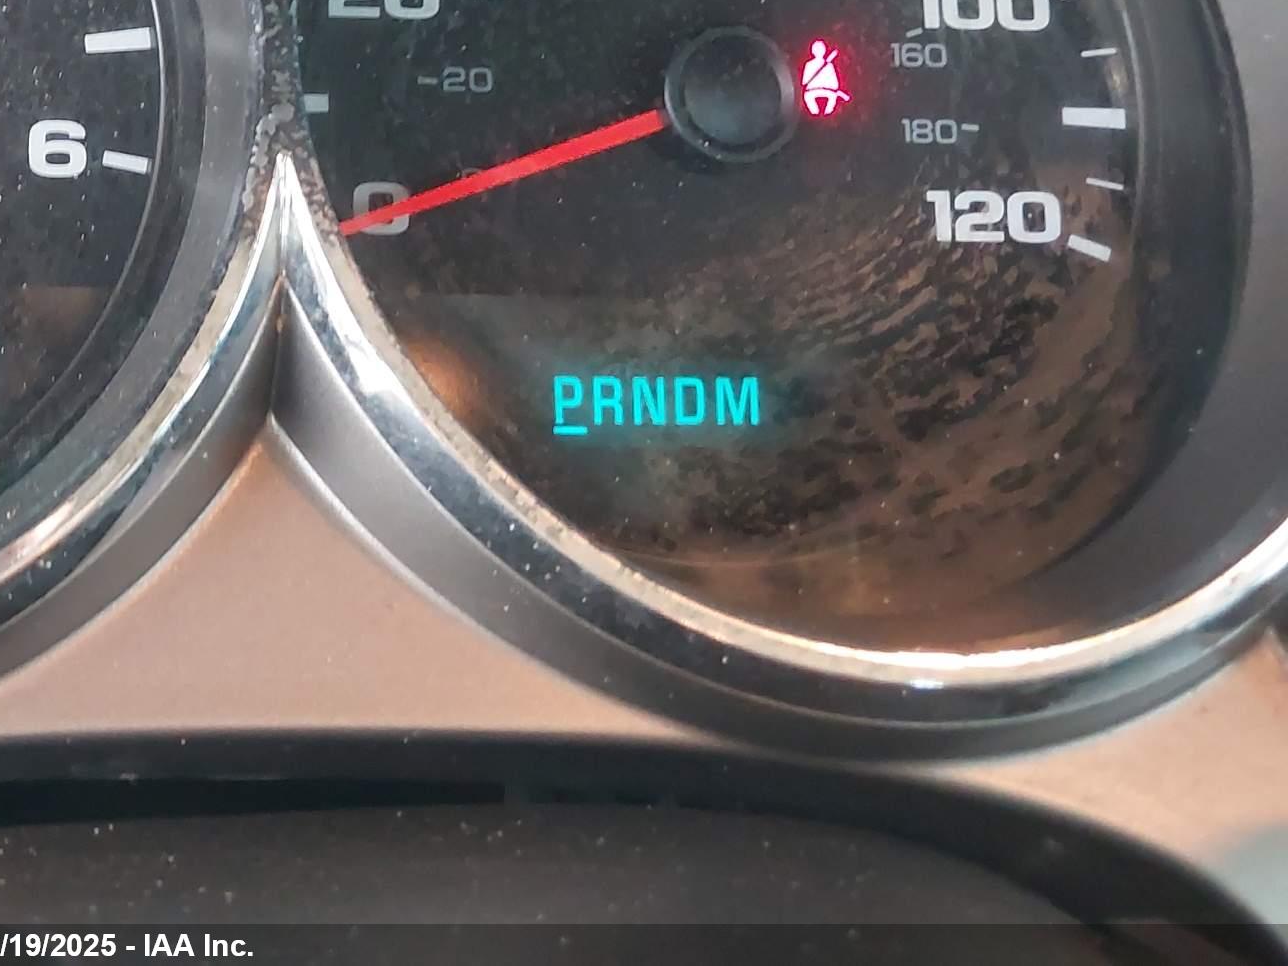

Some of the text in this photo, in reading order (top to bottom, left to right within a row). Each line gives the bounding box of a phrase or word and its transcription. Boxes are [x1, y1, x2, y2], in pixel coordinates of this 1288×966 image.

[890, 42, 948, 68] 160
[442, 67, 493, 92] 20
[27, 120, 88, 178] 6
[901, 117, 958, 144] 180
[926, 190, 1061, 243] 120
[552, 375, 761, 435] PRNDM
